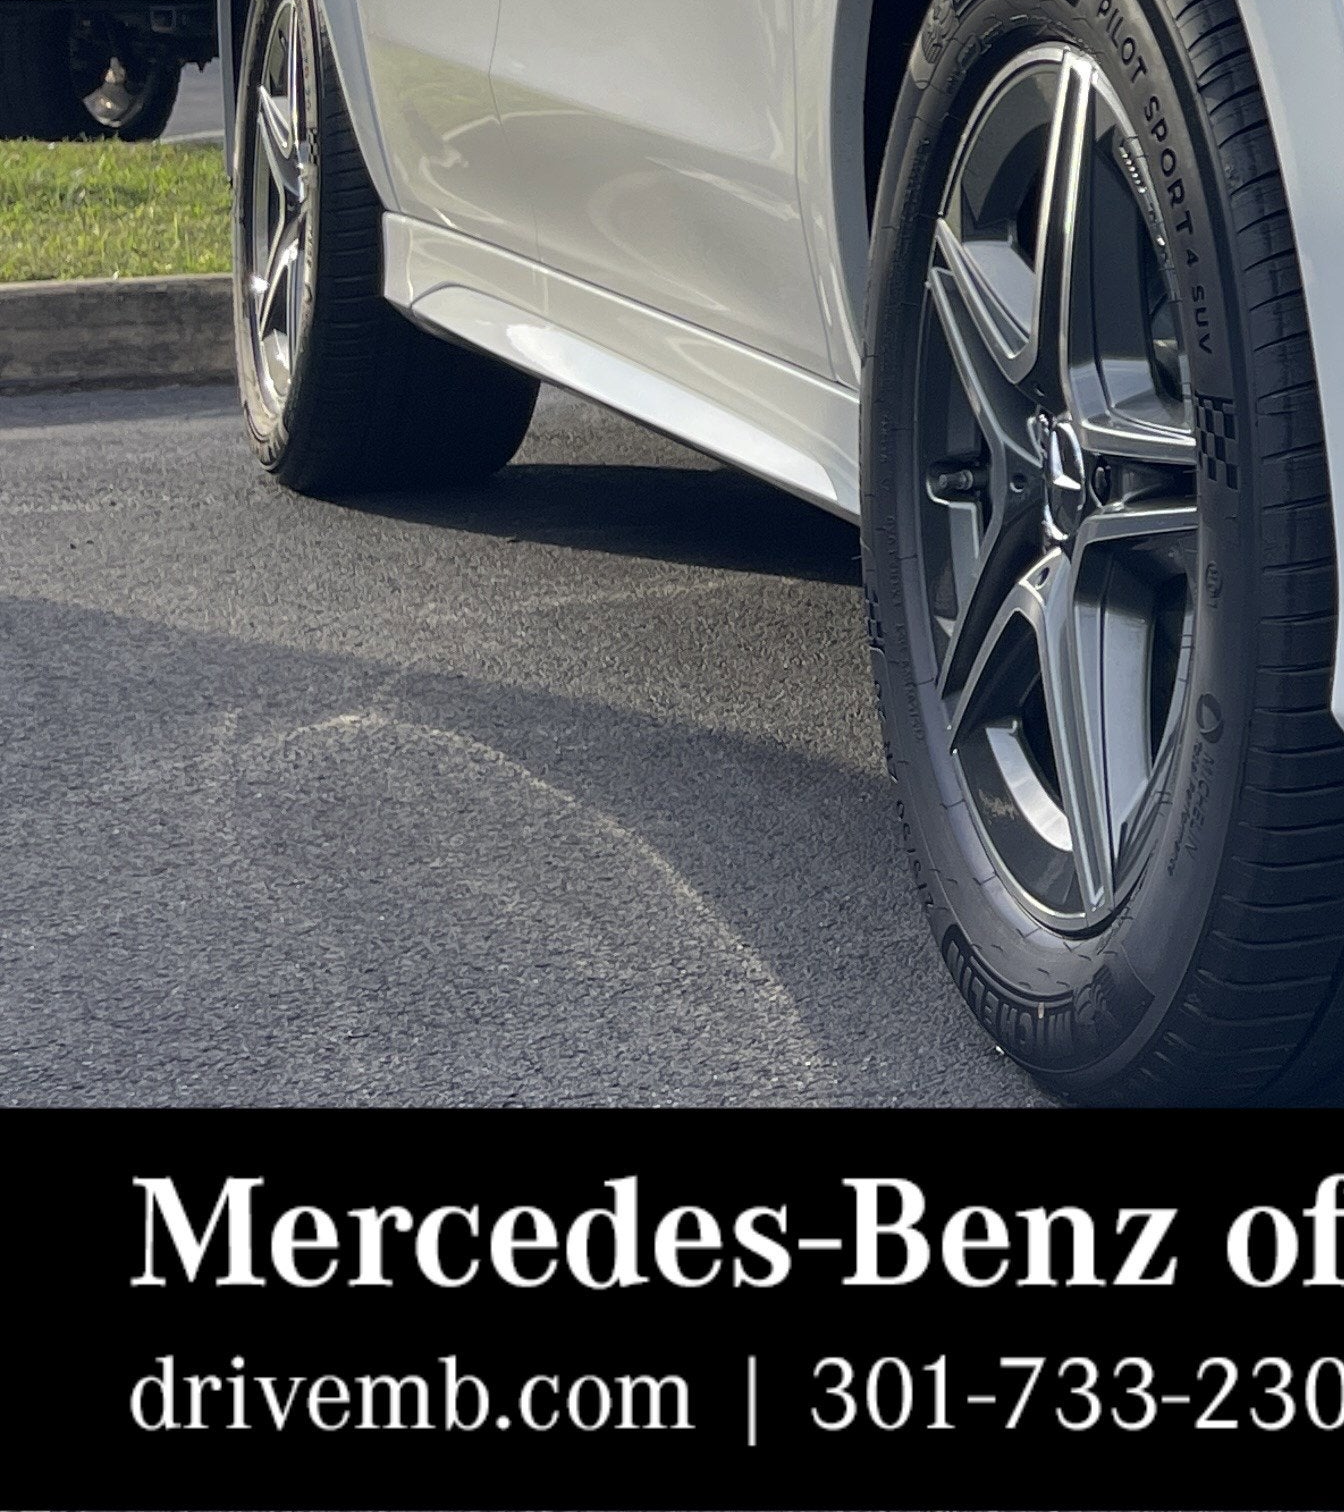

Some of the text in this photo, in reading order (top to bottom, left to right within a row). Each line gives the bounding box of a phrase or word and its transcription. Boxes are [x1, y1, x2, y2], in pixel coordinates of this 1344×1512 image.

[1143, 95, 1195, 237] SPORT
[1185, 248, 1201, 268] 4
[1190, 284, 1214, 356] SUV
[946, 940, 1073, 1048] MICHELIN
